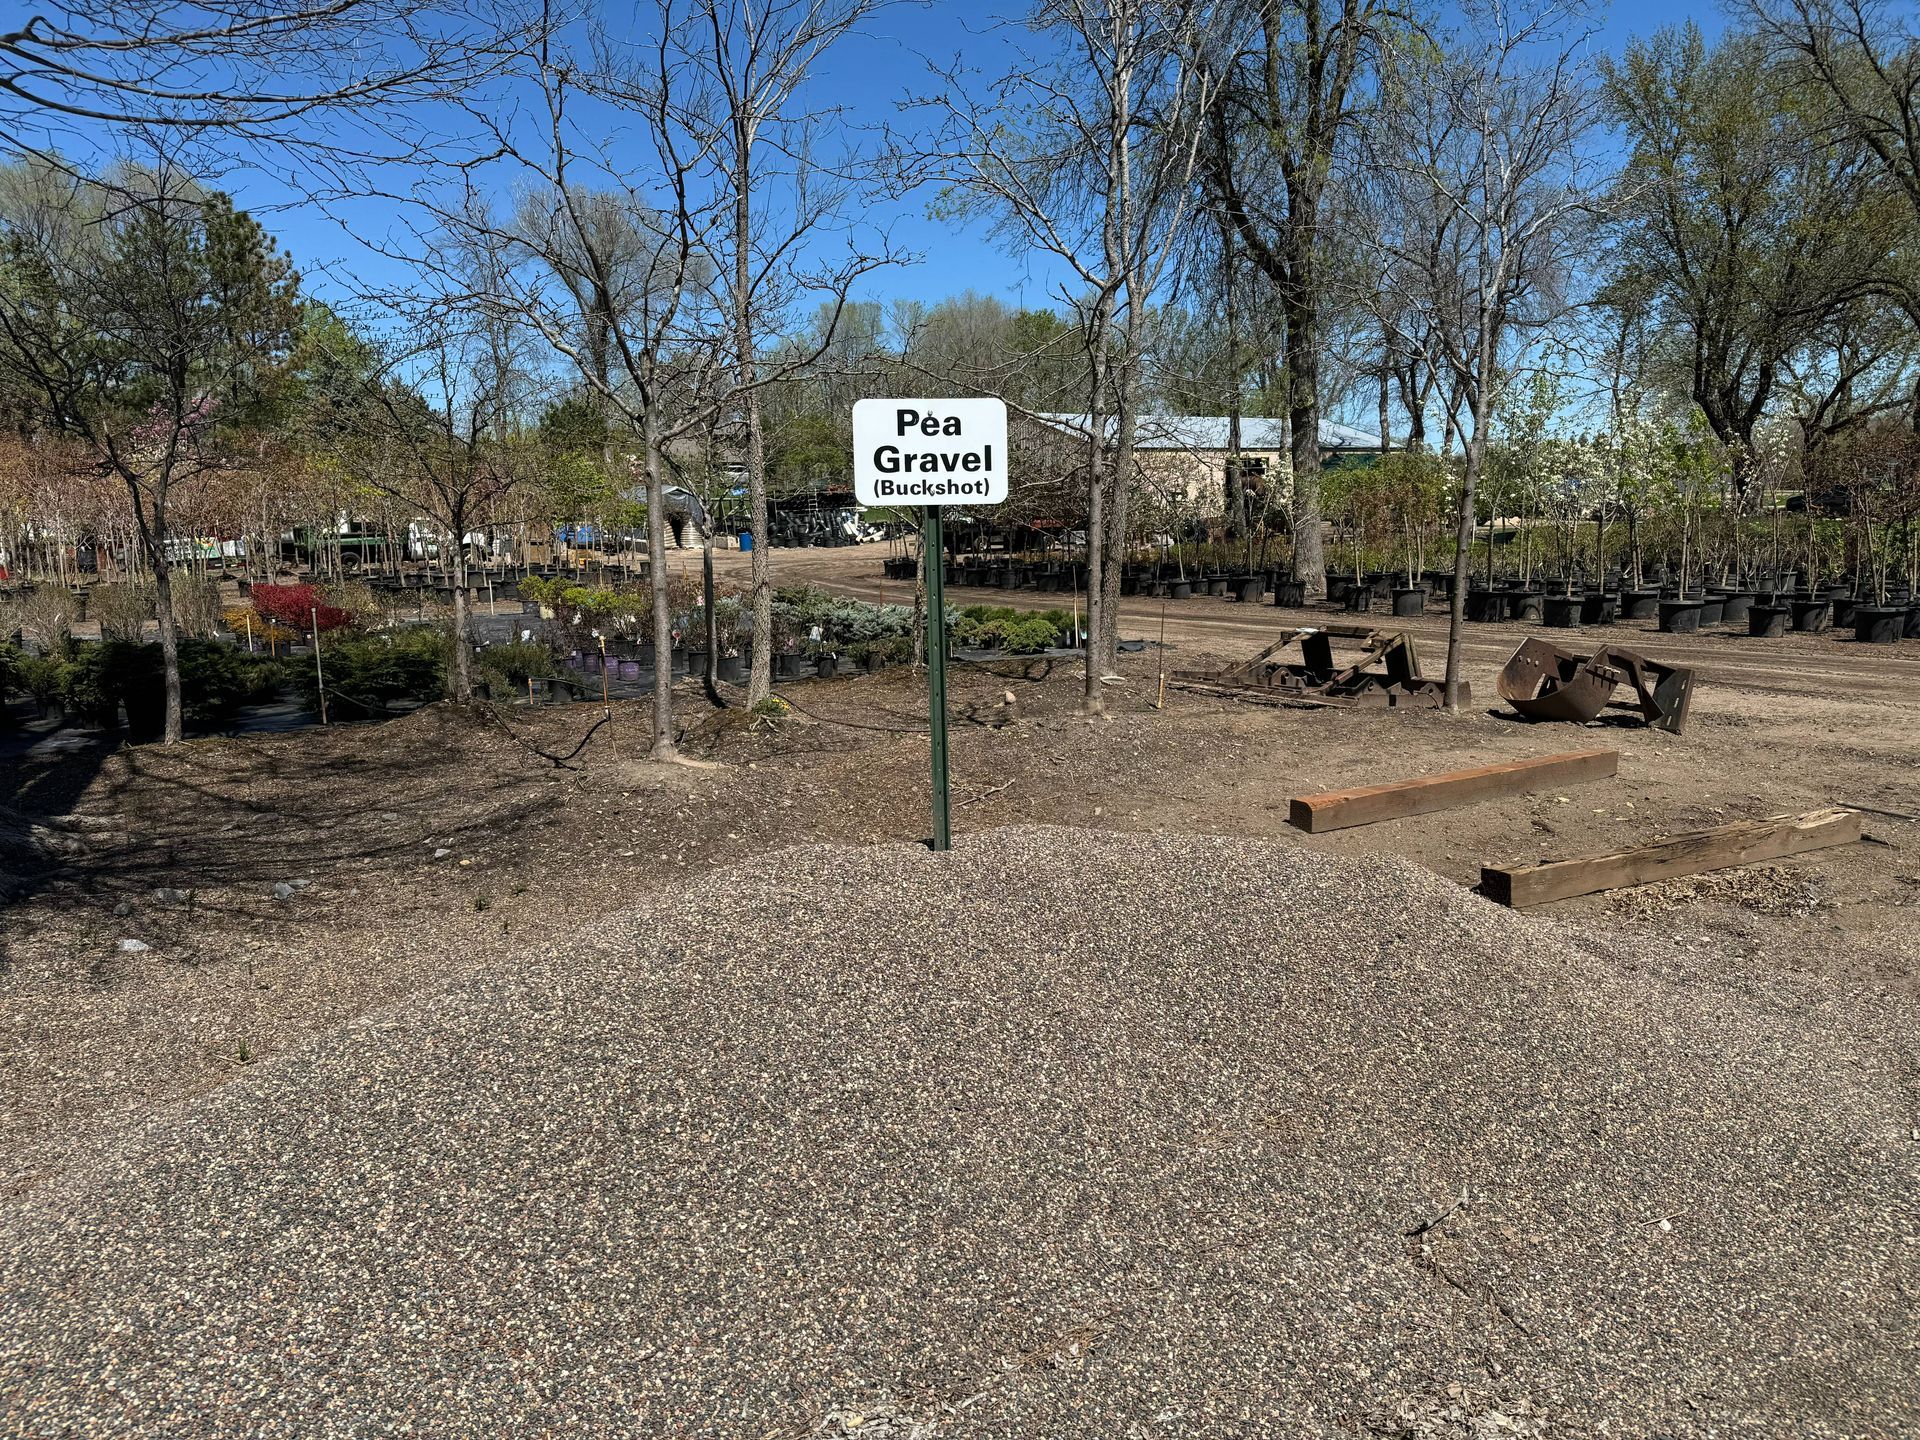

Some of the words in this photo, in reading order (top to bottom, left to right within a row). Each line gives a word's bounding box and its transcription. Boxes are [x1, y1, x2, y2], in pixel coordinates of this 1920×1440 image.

[897, 409, 961, 436] Pea
[873, 444, 992, 473] Gravel
[874, 478, 990, 498] (Buckshot)
